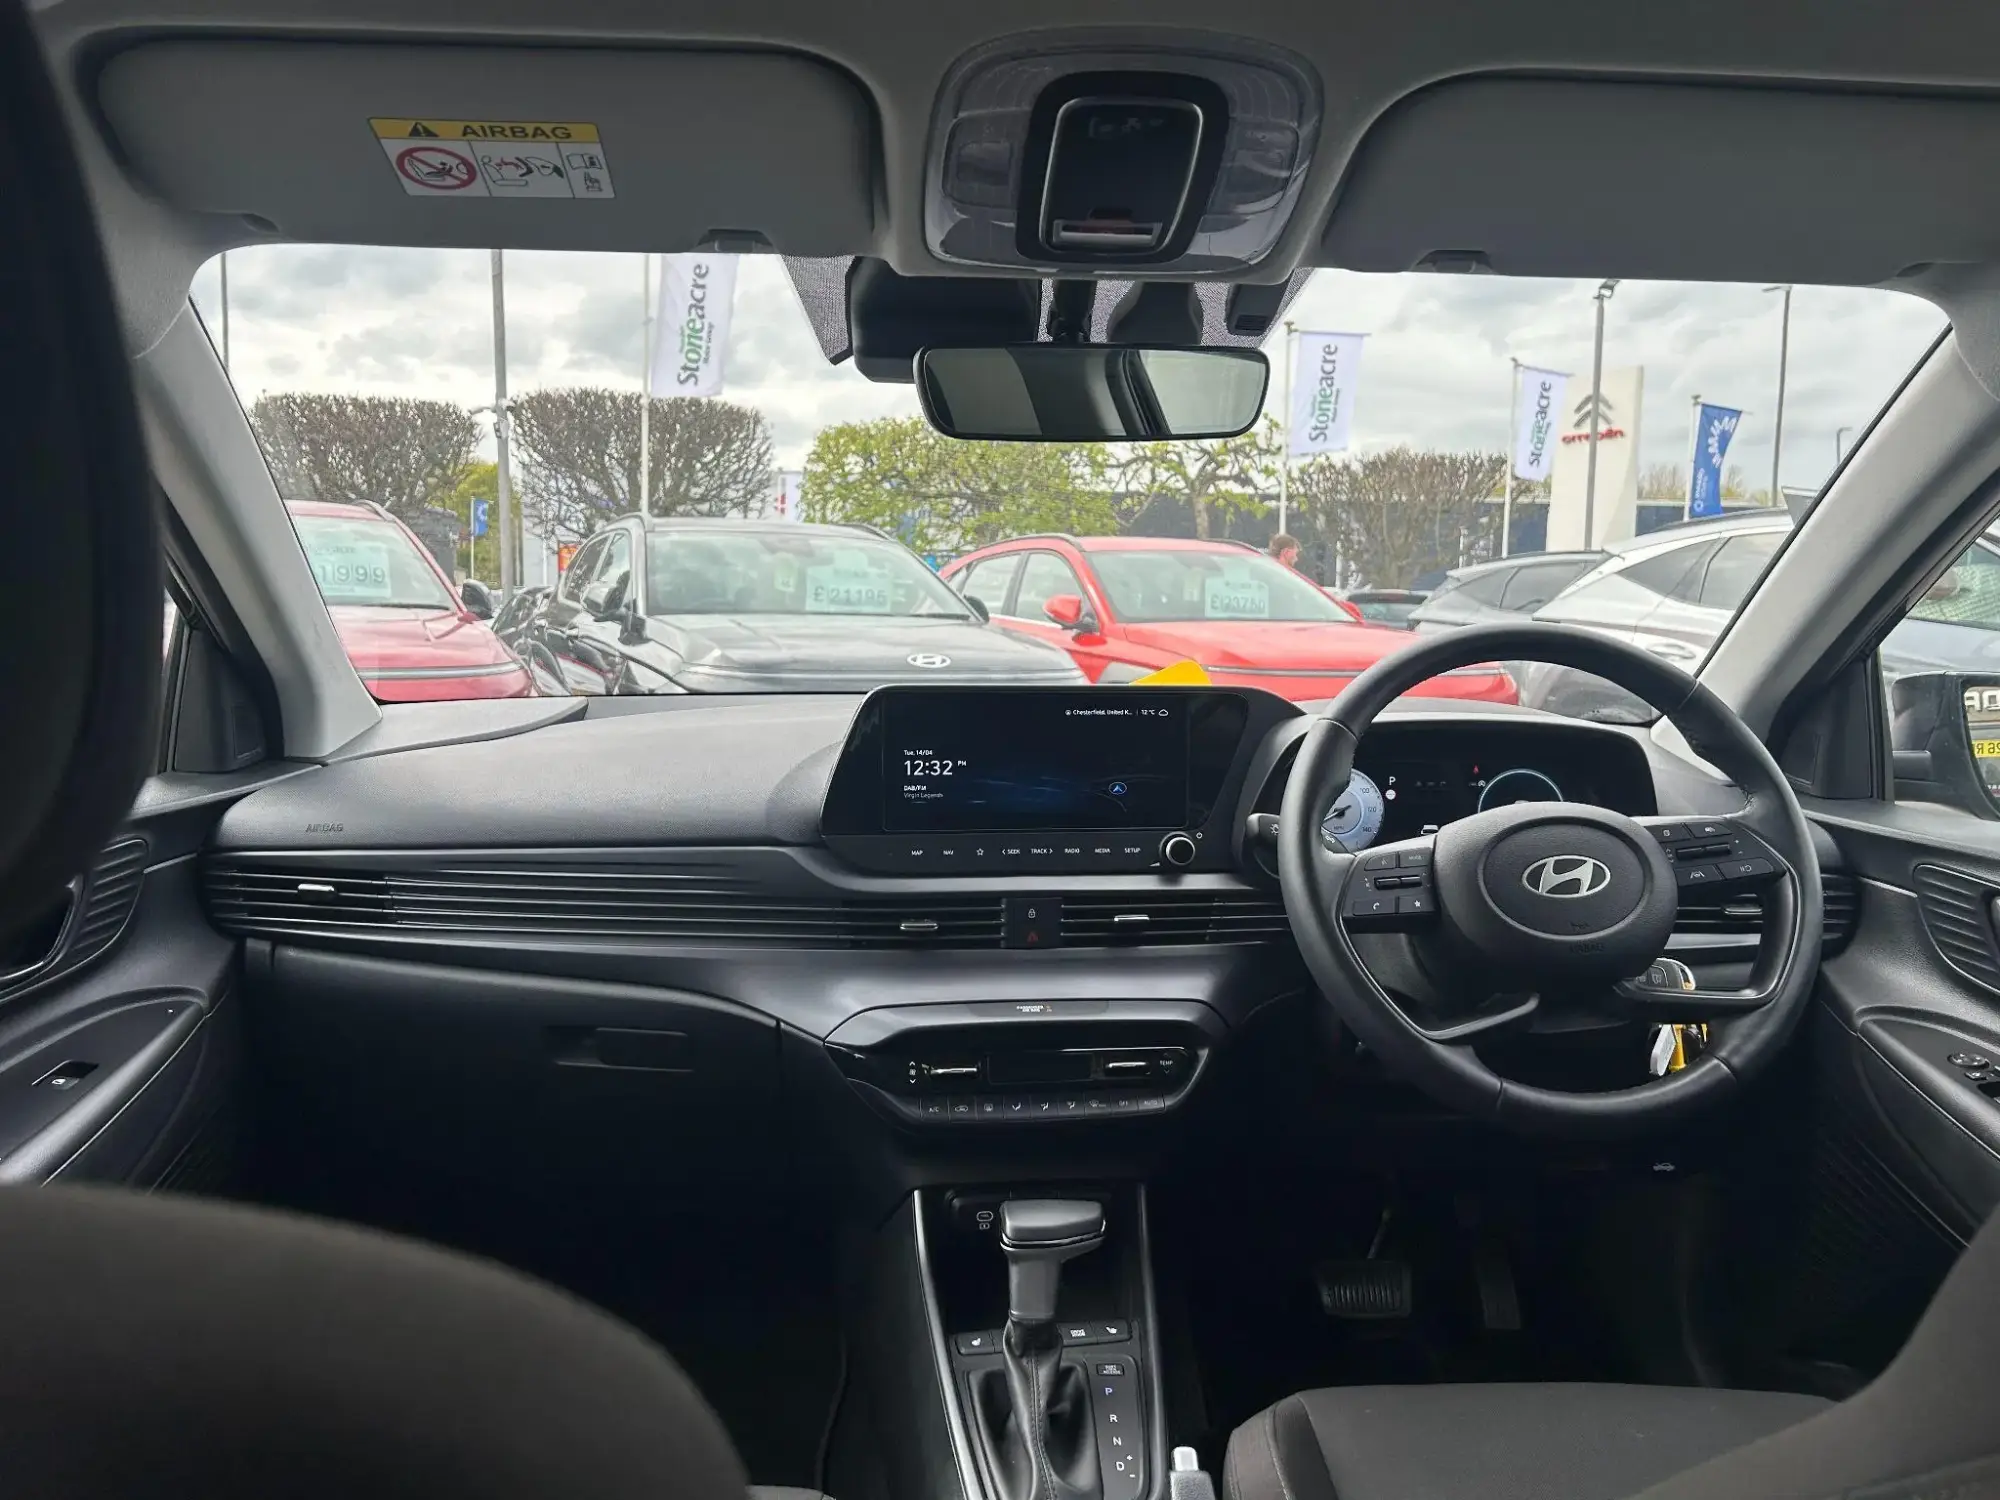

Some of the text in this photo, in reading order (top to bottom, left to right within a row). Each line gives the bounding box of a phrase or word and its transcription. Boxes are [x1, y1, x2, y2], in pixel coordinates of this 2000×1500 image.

[461, 124, 572, 140] AIRBAG
[676, 263, 710, 387] Stoneacre
[1308, 343, 1339, 443] Stoneacre
[1529, 380, 1552, 469] Stoneacre
[319, 564, 386, 584] 1999
[904, 760, 953, 776] 12:32
[1389, 776, 1396, 786] P
[1105, 1387, 1113, 1395] P
[1109, 1414, 1118, 1422] R
[1113, 1436, 1122, 1446] N
[1116, 1461, 1125, 1471] D
